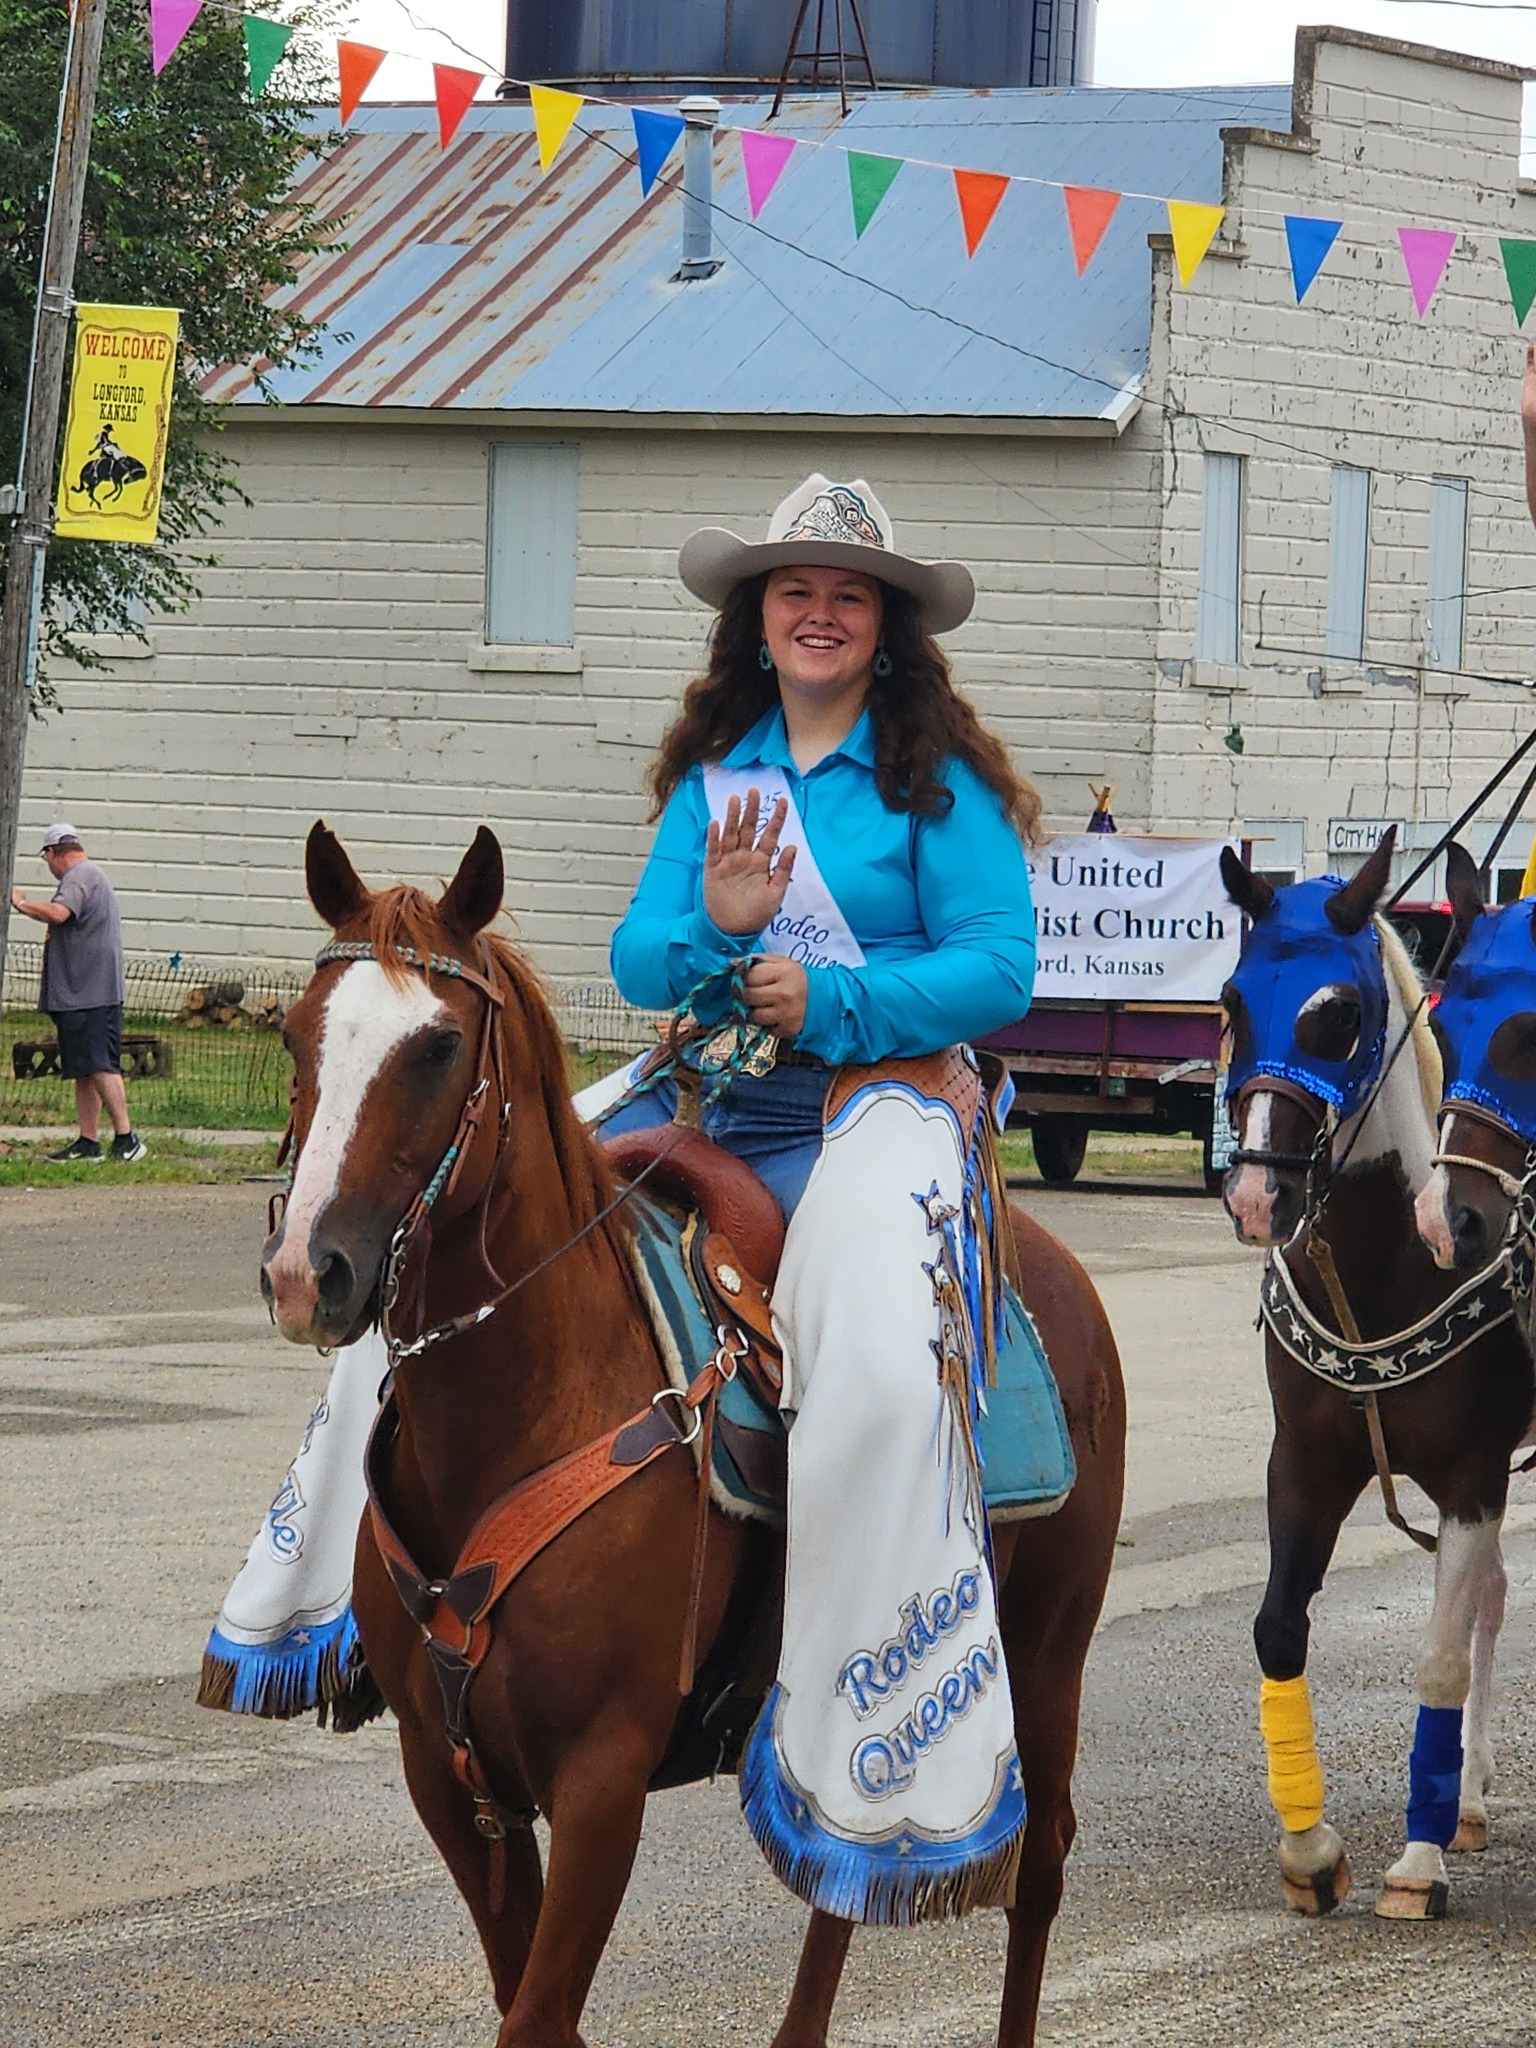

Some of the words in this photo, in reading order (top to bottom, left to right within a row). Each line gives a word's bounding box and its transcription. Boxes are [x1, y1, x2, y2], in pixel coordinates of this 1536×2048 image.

[86, 333, 167, 361] WELCOME
[119, 364, 127, 379] TO
[93, 383, 146, 406] LONGFORD,
[99, 403, 138, 422] KANSAS
[1335, 826, 1364, 848] CITY
[1049, 855, 1164, 888] United
[1093, 908, 1225, 940] Church
[1084, 954, 1165, 976] Kansas
[837, 1569, 981, 1717] Rodeo
[853, 1638, 998, 1800] Queen
